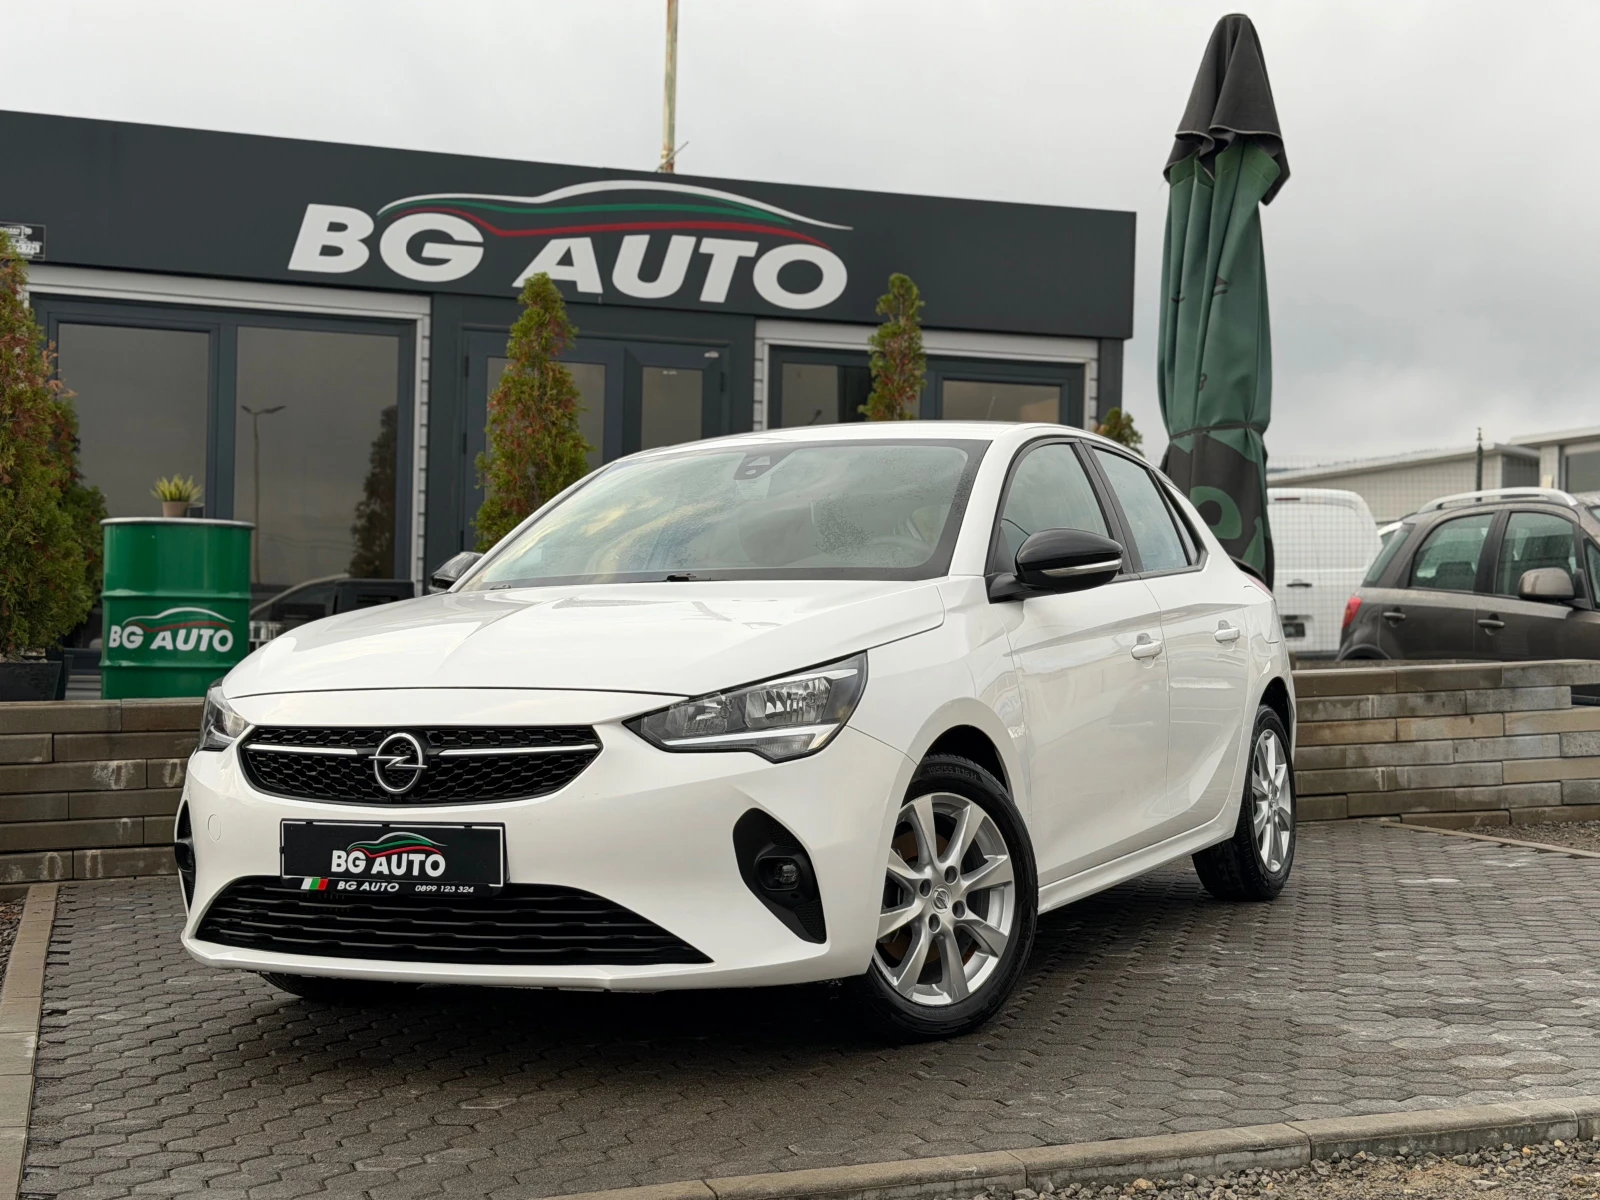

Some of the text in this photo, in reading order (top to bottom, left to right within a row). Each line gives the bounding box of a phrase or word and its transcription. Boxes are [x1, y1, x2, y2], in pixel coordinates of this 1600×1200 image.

[288, 203, 848, 309] BG AUTO
[108, 625, 234, 652] BG AUTO
[331, 850, 446, 877] BG AUTO
[337, 881, 399, 892] BG AUTO
[440, 885, 456, 893] 123
